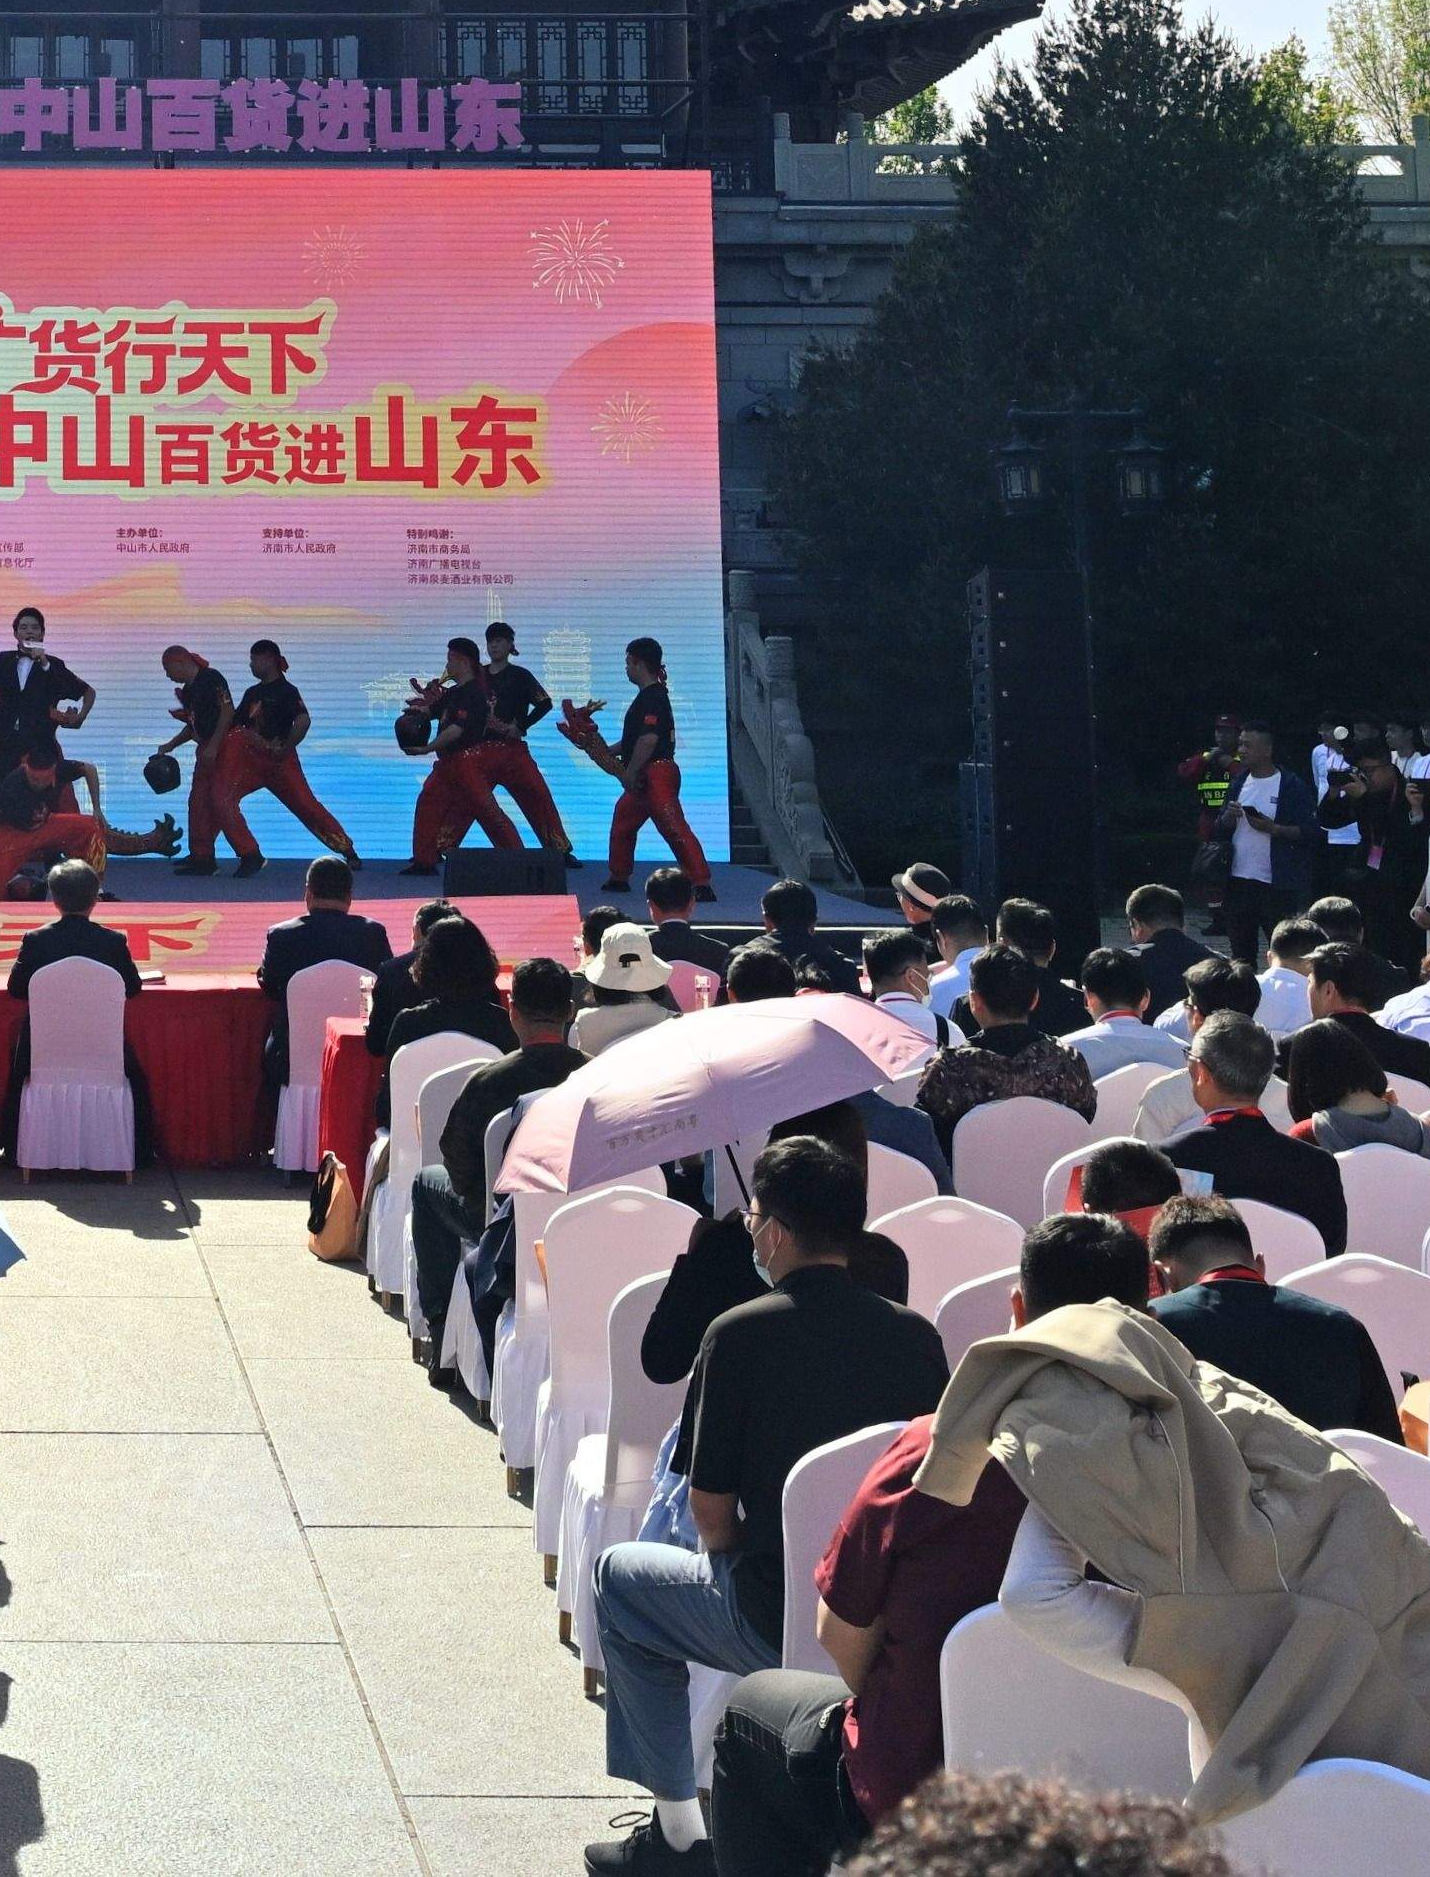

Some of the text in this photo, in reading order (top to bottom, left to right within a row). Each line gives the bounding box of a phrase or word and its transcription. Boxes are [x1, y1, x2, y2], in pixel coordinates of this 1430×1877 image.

[115, 542, 190, 553] 中山市人民政府
[261, 543, 336, 554] 济南市人民政府
[407, 544, 471, 555] 济南市商务局
[407, 559, 482, 570] 济南广播电视台
